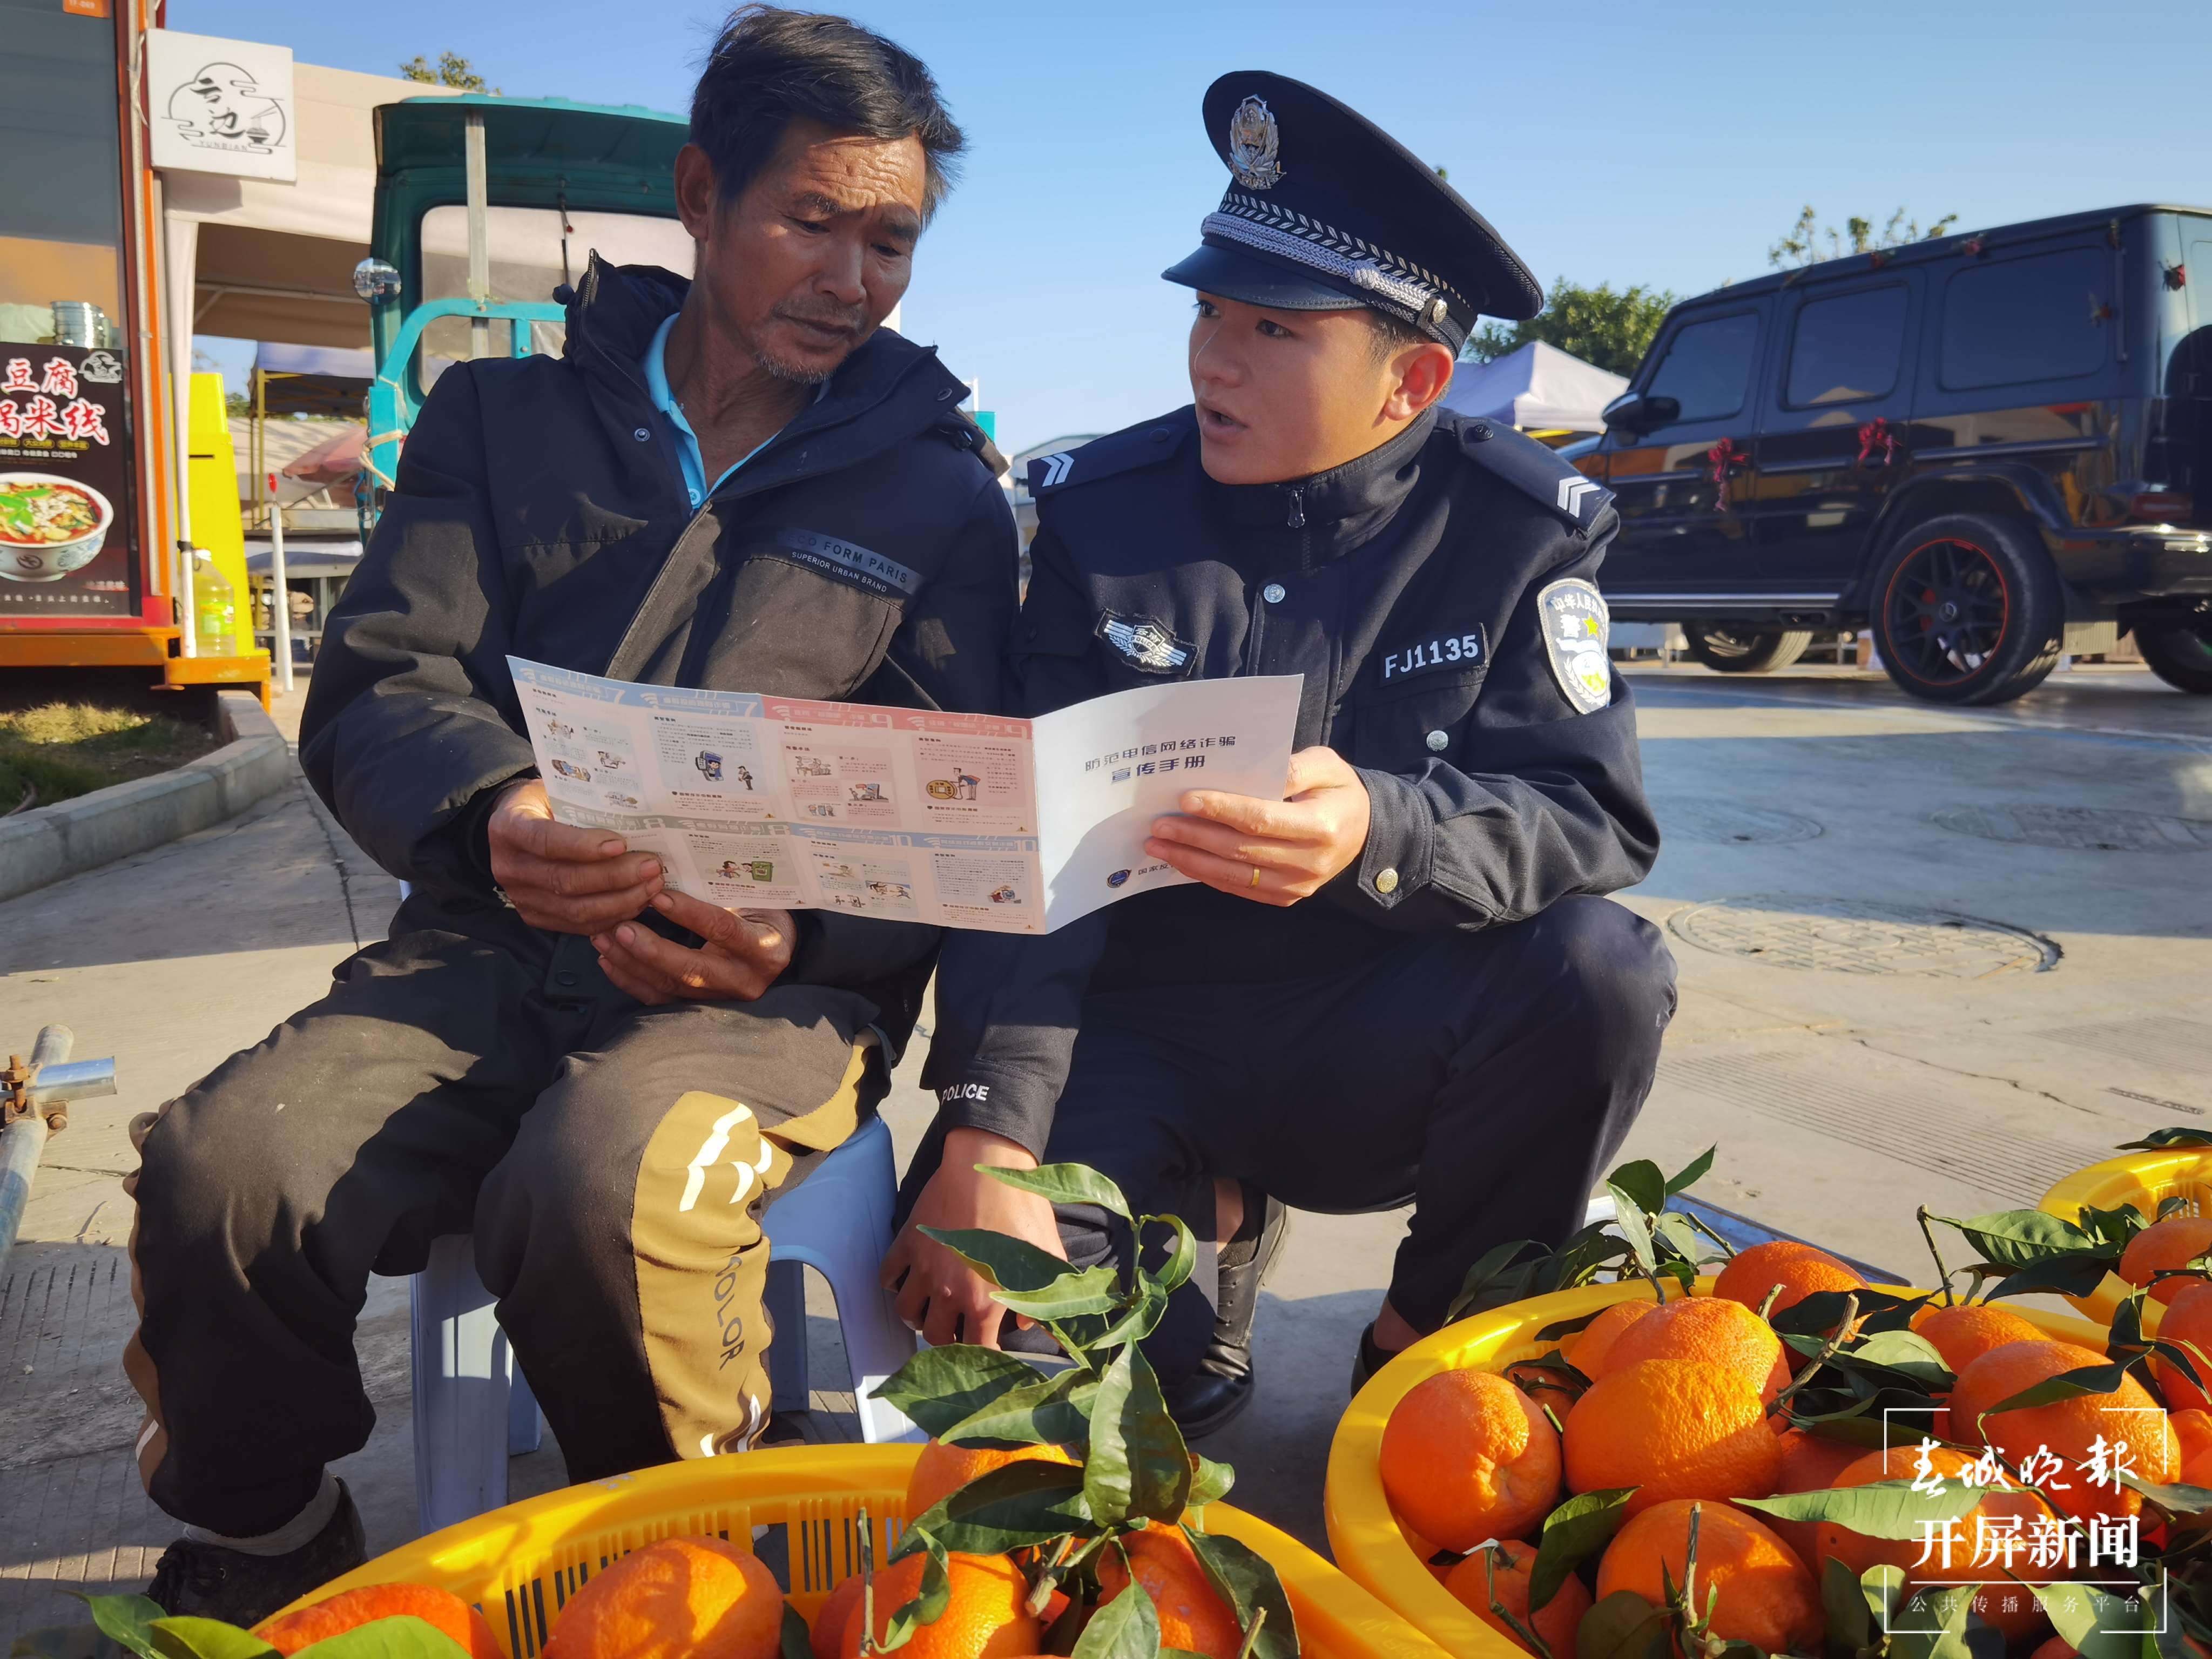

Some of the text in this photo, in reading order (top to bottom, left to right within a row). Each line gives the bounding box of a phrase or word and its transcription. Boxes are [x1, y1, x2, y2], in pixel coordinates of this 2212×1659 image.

[200, 140, 248, 152] YUNBIAN
[1, 356, 78, 399] 豆腐
[792, 551, 887, 592] SUPERIOR URBAN BRAND
[824, 542, 864, 563] FORM
[869, 557, 908, 583] PARIS
[1132, 636, 1156, 651] POLICE
[1385, 635, 1479, 678] FJ1135
[1085, 736, 1236, 772] 防范电信网络诈骗
[1110, 755, 1205, 784] 宣传手册
[1138, 864, 1173, 875] 国家反
[941, 1084, 989, 1105] POLICE
